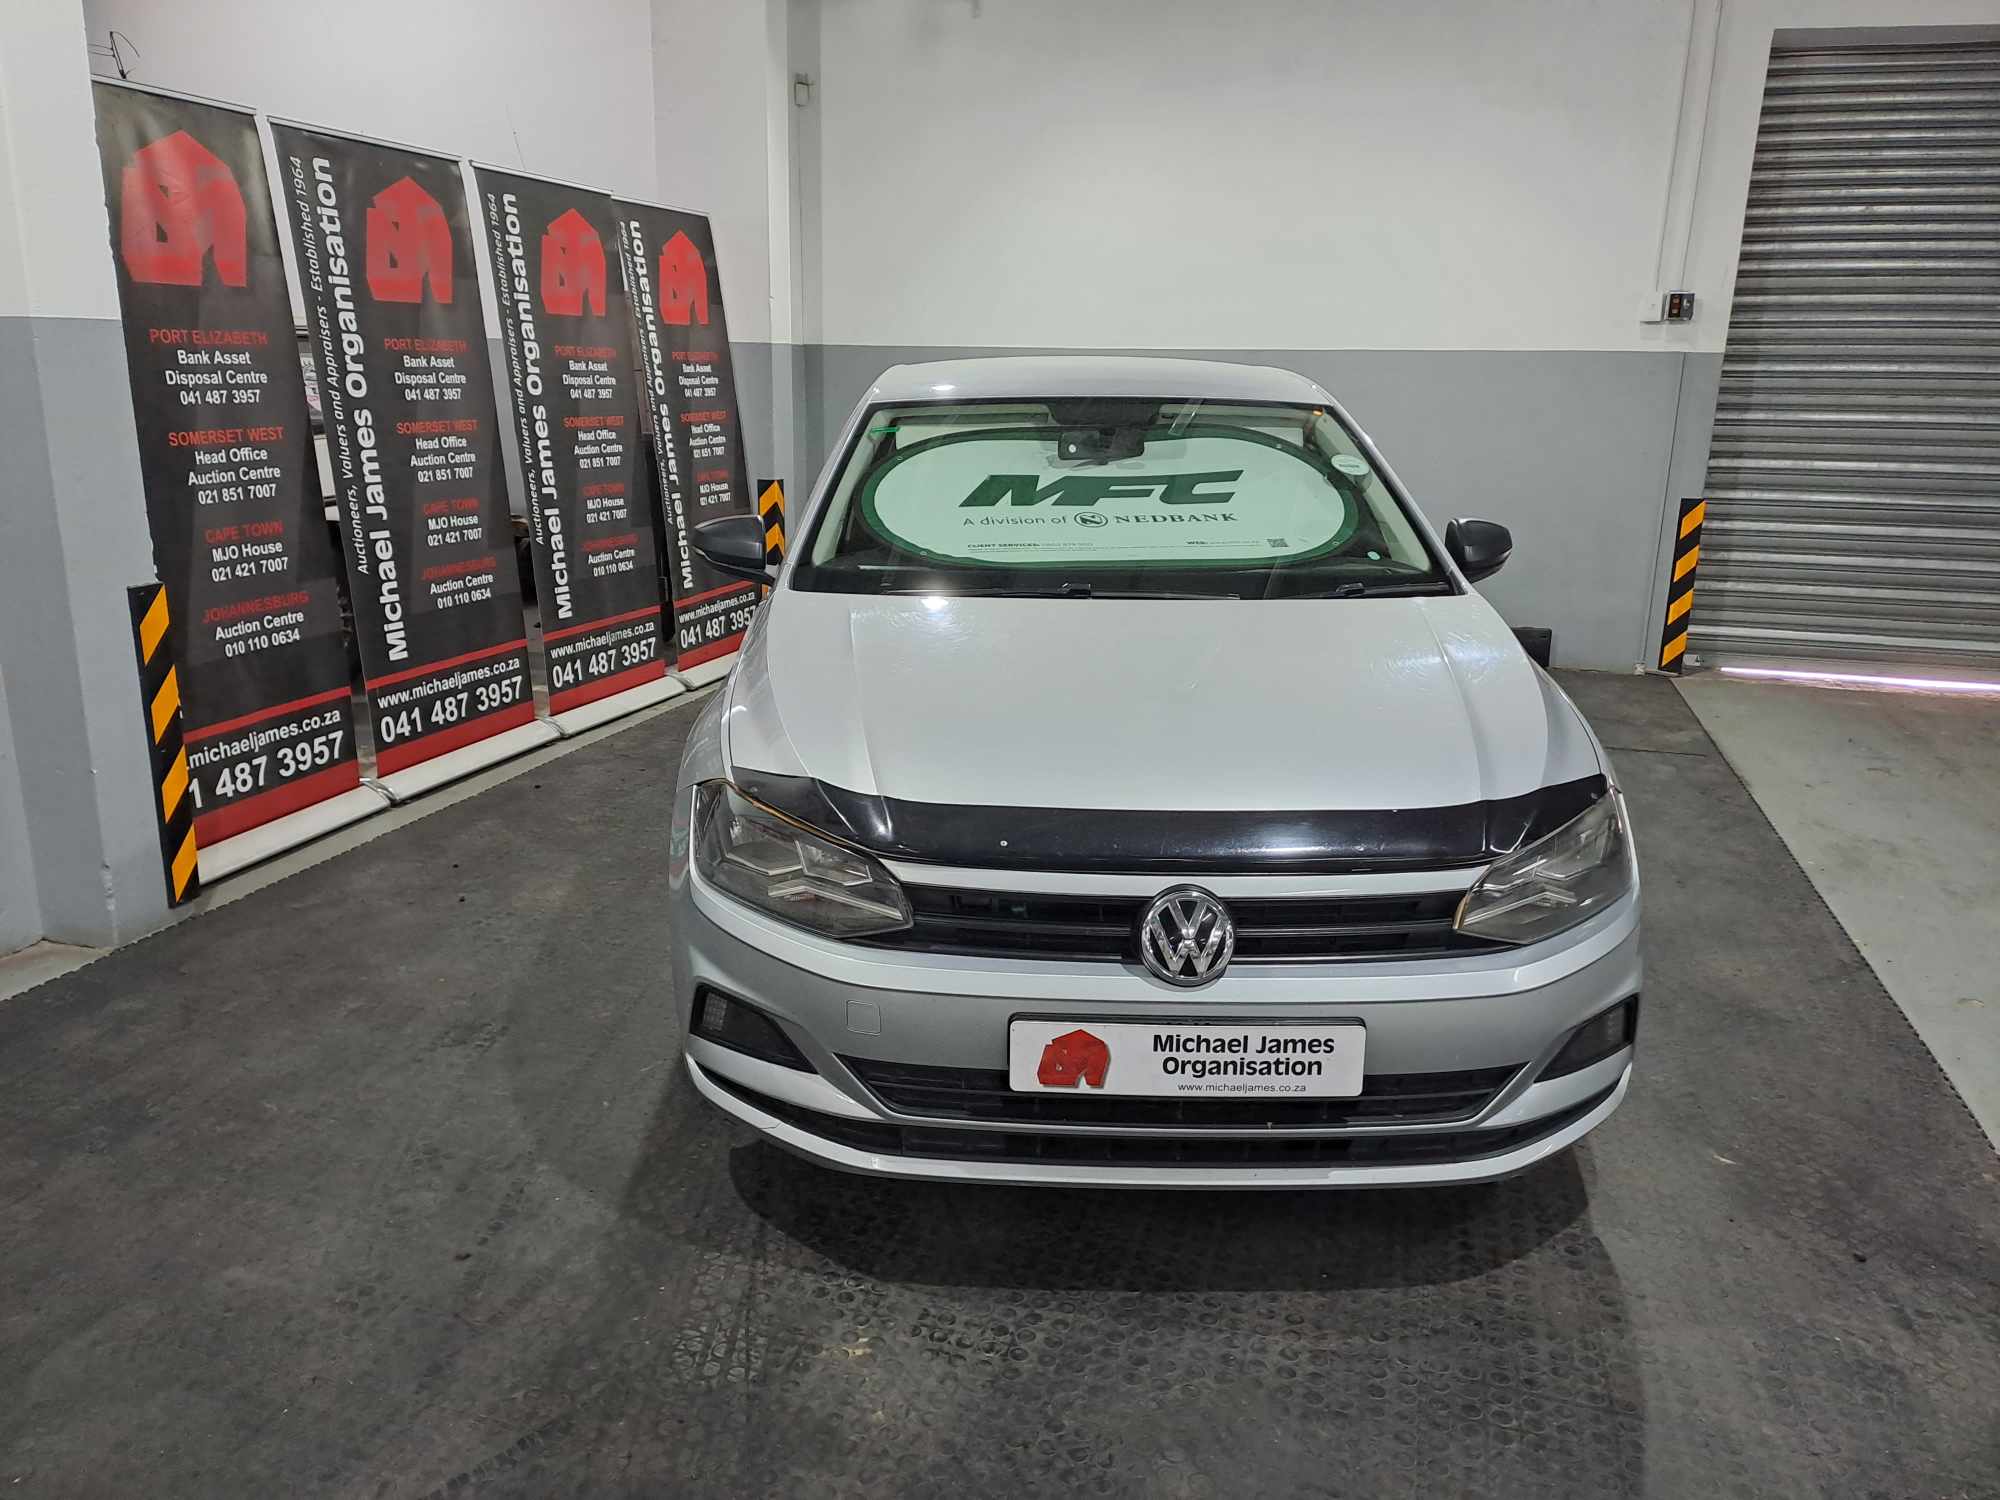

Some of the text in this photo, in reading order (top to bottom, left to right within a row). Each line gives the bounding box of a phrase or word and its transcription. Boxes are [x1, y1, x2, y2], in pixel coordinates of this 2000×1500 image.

[491, 229, 511, 306] Established
[149, 329, 188, 343] PORT
[177, 350, 251, 364] Bank Asset
[403, 355, 455, 368] Bank Asset
[506, 318, 522, 386] Appraisers
[290, 156, 369, 575] Auctioneers, Valuers and Appraisers Established 1964
[165, 370, 268, 387] Disposal Centre
[394, 372, 467, 386] Disposal Centre
[562, 374, 617, 387] Disposal Centre
[180, 389, 260, 405] 041 487 3957
[405, 388, 462, 401] 041 487 3957
[515, 389, 526, 414] and
[312, 157, 409, 662] Michael James Organisation
[503, 194, 573, 619] Michael James Organisation
[168, 426, 284, 446] SOMERSET WEST
[416, 436, 467, 450] Head Office
[520, 417, 533, 464] Valuers
[596, 429, 616, 440] Office
[660, 403, 679, 486] James
[195, 447, 268, 465] Head Office
[574, 443, 623, 455] Auction Centre
[410, 452, 476, 468] Auction Centre
[188, 466, 281, 486] Auction Centre
[418, 467, 473, 483] 021 851 7007
[198, 484, 277, 504] 021 851 7007
[958, 469, 1244, 507] MFC
[428, 515, 478, 530] MJO House
[963, 513, 1238, 526] A division of NEDBANK
[427, 528, 482, 546] 021 421 7007
[671, 492, 694, 589] Michael
[212, 541, 282, 562] MJO House
[588, 552, 613, 565] Auction
[211, 557, 289, 582] 021 421 7007
[430, 574, 493, 594] Auction Centre
[437, 587, 491, 609] 010 110 0634
[679, 592, 756, 624] www.michaeljames.co.za
[215, 610, 304, 640] Auction Centre
[680, 624, 702, 649] 041
[706, 615, 726, 639] 487
[225, 628, 300, 657] 010 110 0634
[550, 622, 655, 659] www.michaeljames.co.za
[553, 637, 656, 688] 041 487 3957
[377, 658, 520, 709] www.michaeljames.co.za
[381, 675, 523, 743] 041 487 3957
[215, 755, 267, 798] 487
[277, 730, 343, 777] 3957
[1153, 1034, 1335, 1054] Michael James
[1162, 1056, 1323, 1079] Organisation
[1177, 1082, 1307, 1095] www.michaeljames.co.za
